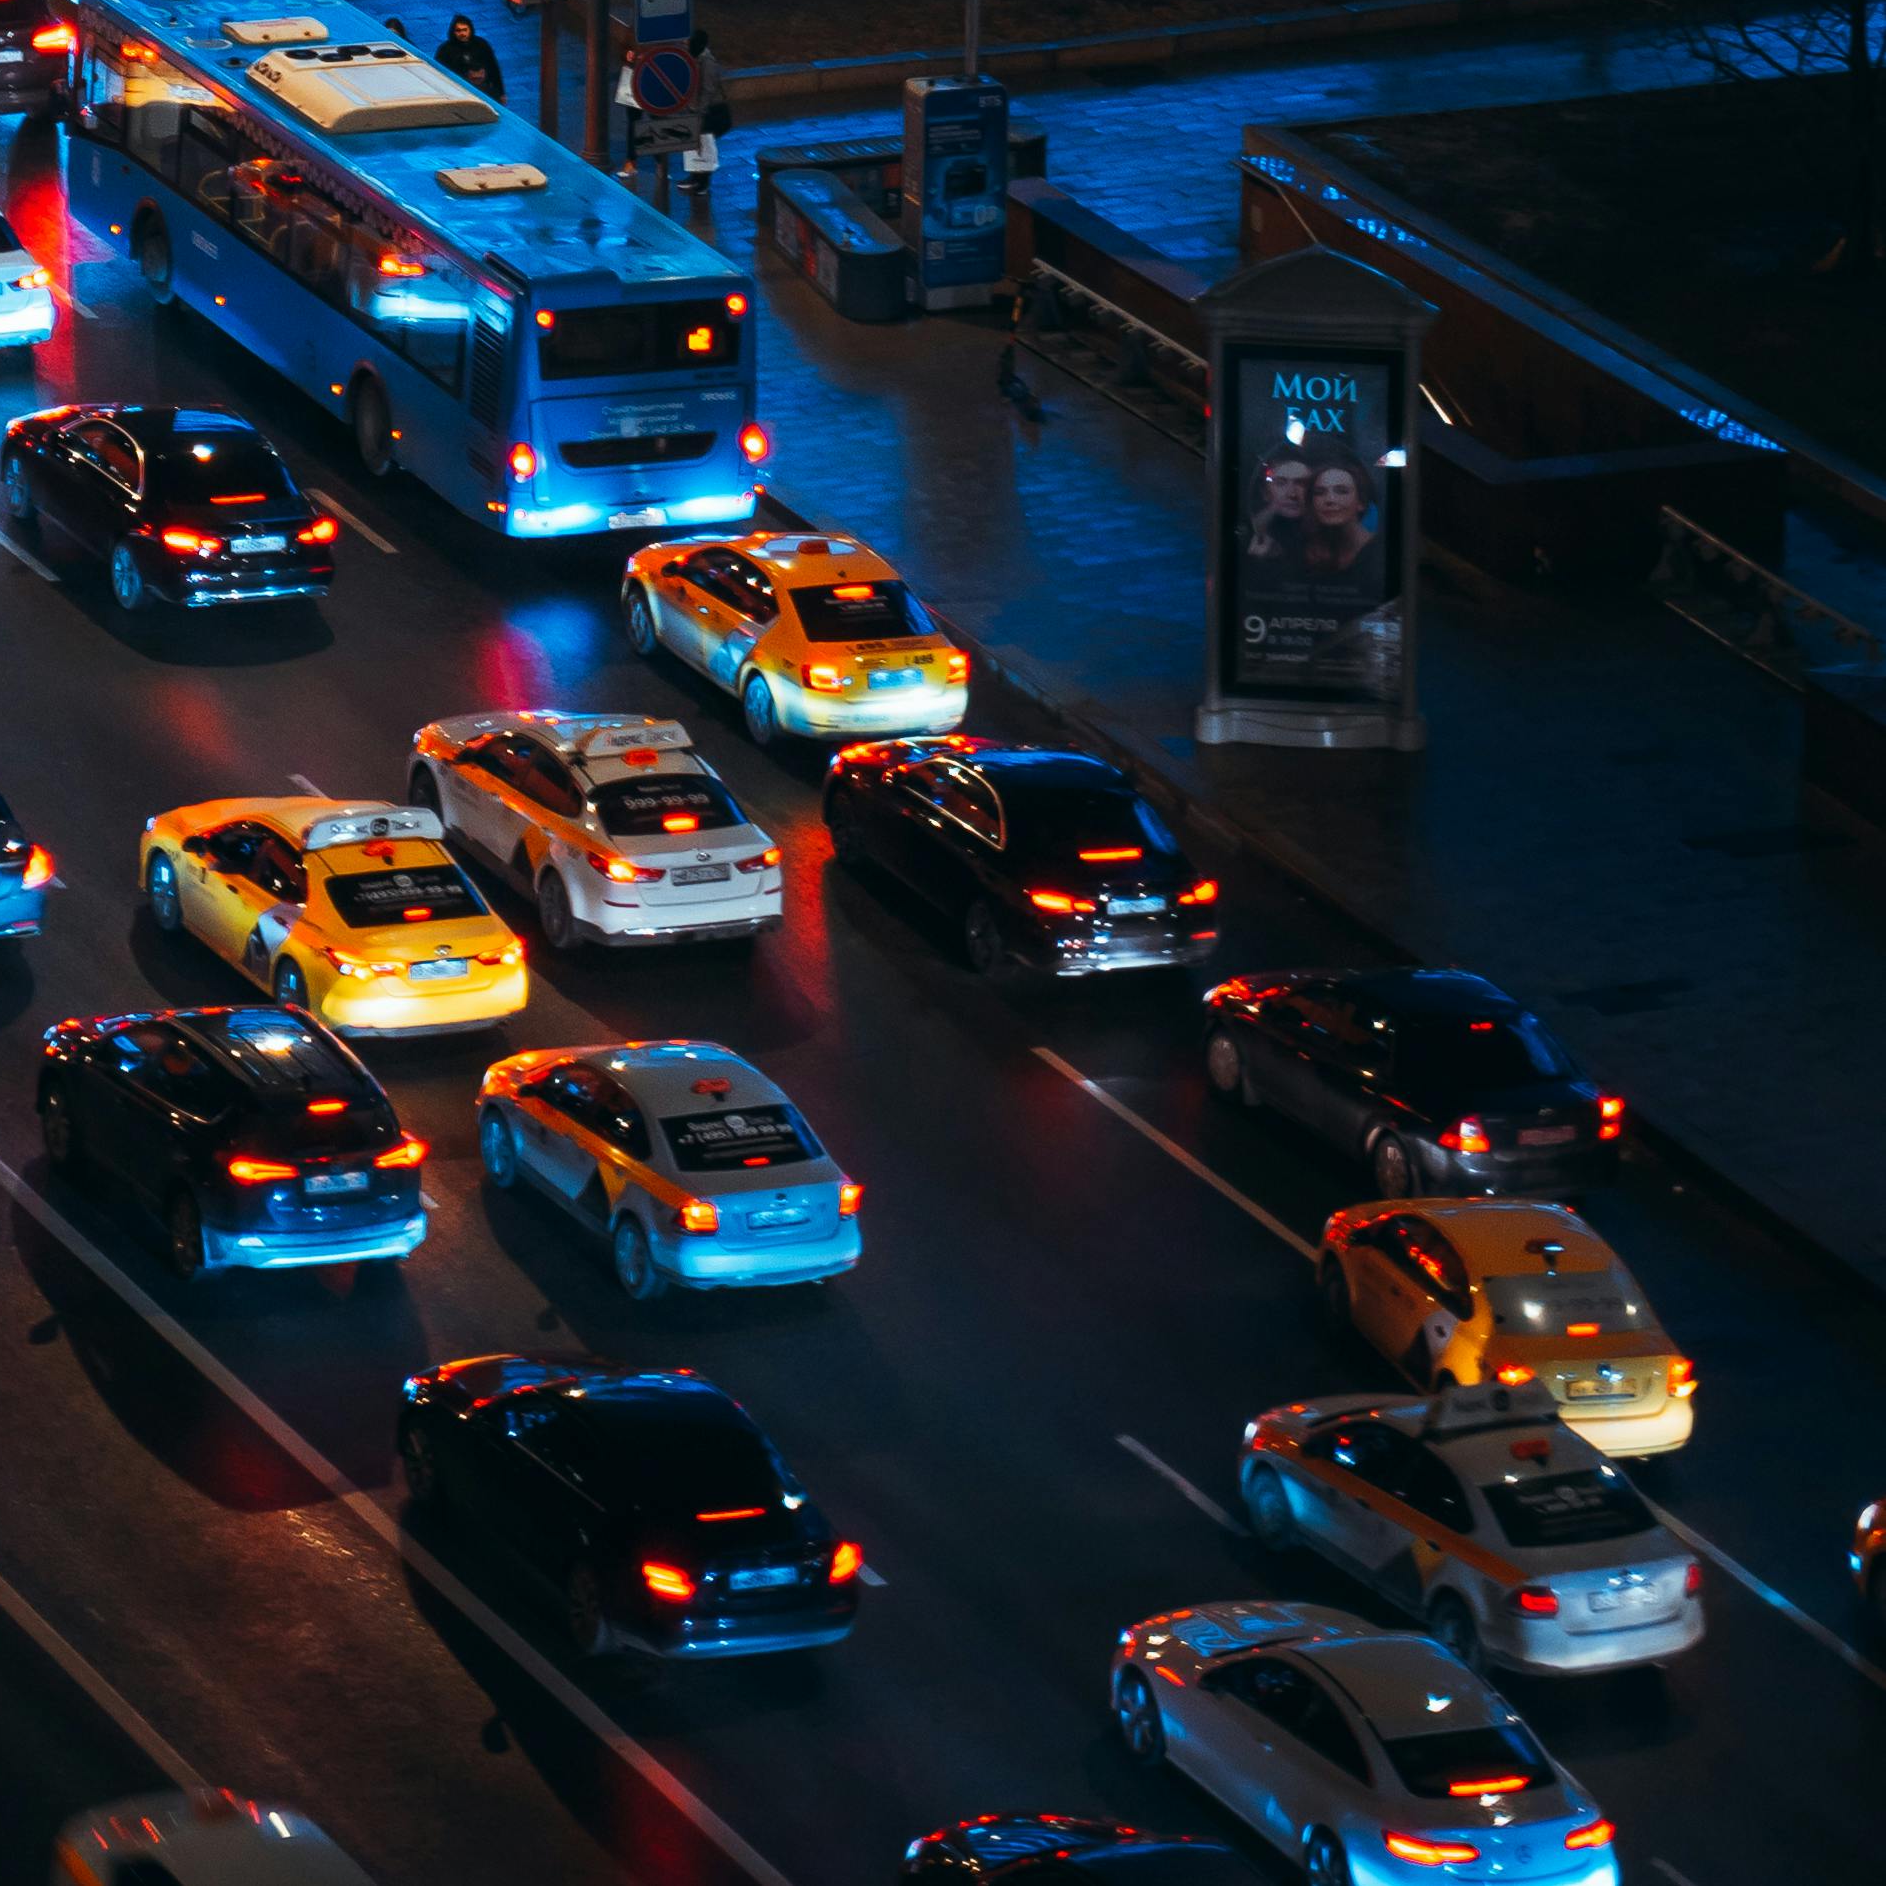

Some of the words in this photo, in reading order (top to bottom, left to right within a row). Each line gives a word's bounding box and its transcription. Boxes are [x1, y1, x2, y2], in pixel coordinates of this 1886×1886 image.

[1271, 371, 1358, 403] МОЙ
[1244, 615, 1267, 643] 9
[1268, 617, 1338, 632] АПРЕЛЯ
